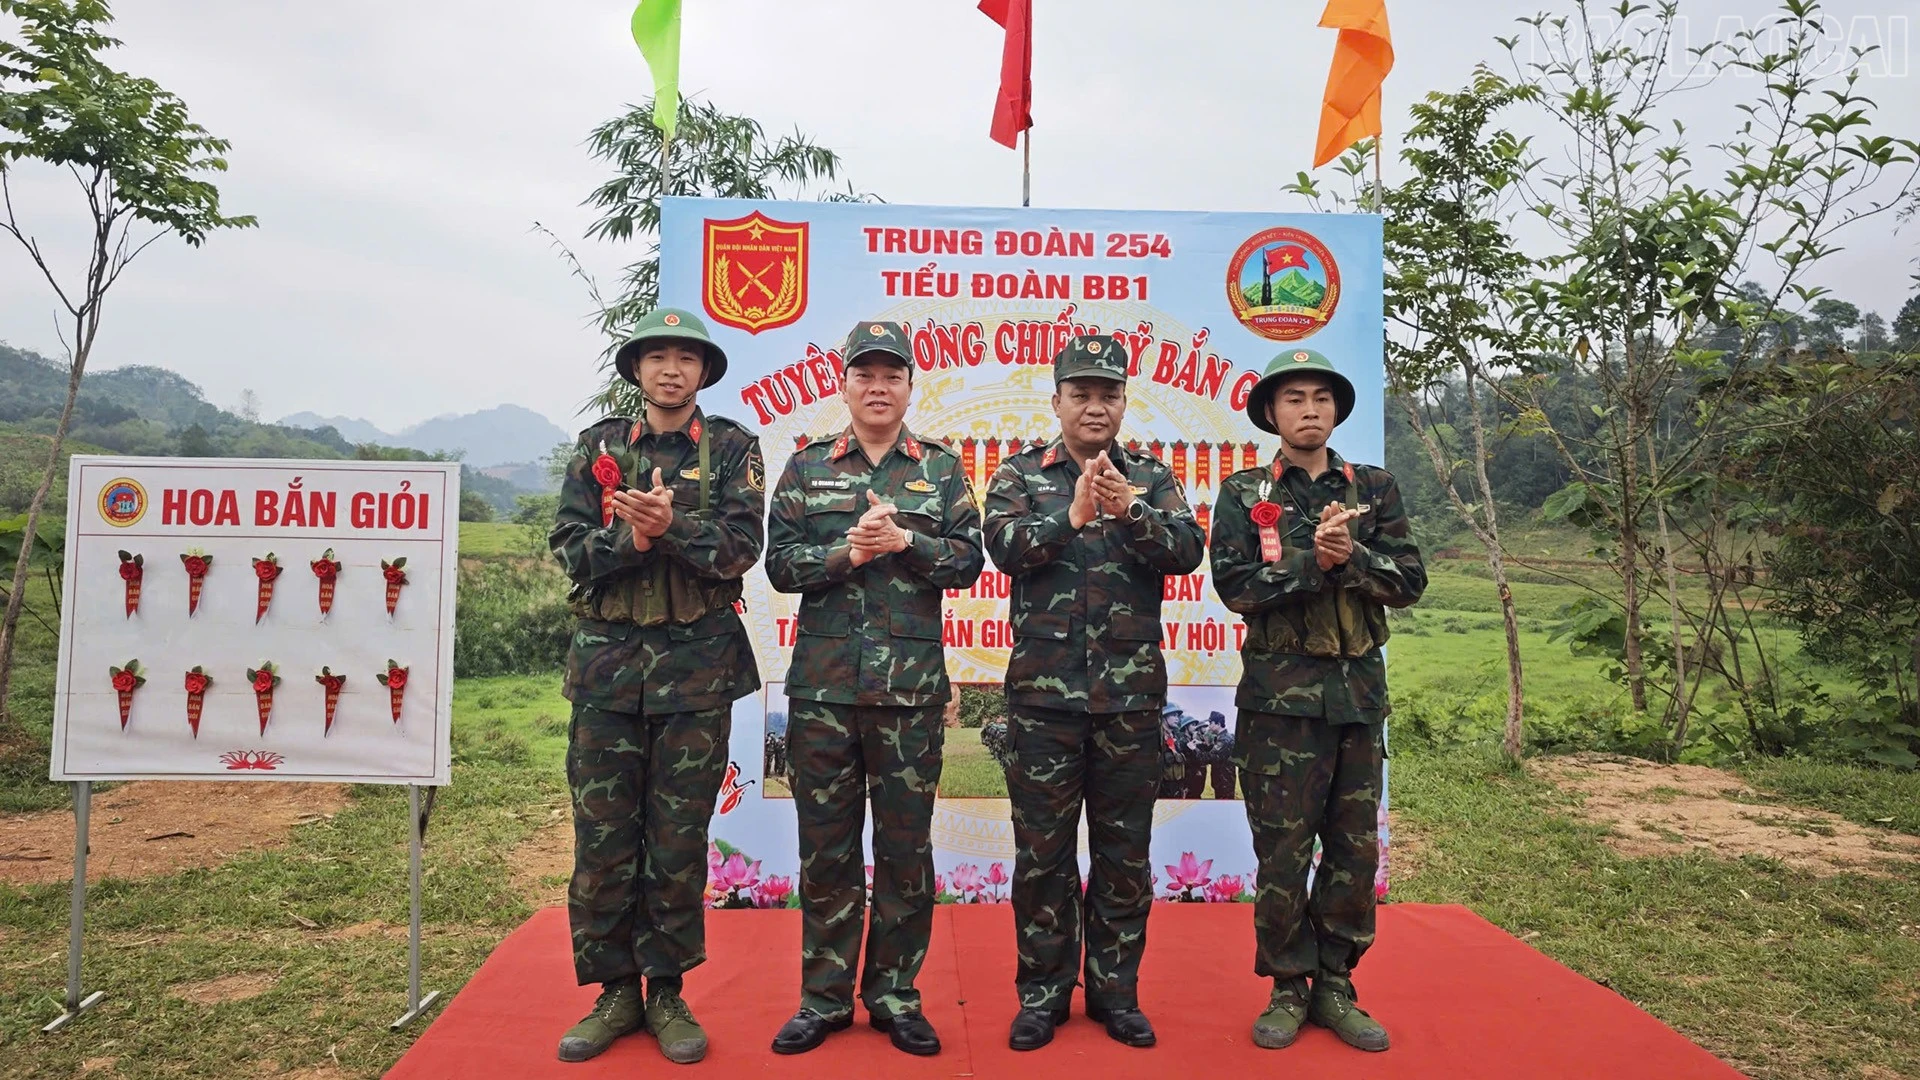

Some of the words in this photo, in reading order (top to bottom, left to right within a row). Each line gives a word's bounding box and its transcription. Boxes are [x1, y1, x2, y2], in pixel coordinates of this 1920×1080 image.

[863, 228, 984, 254] TRUNG
[995, 226, 1094, 257] ĐOÀN
[1106, 233, 1172, 258] 254
[881, 262, 959, 297] TIỂU
[970, 269, 1070, 300] ĐOÀN
[1083, 275, 1147, 301] BB1
[1255, 316, 1278, 324] TRUNG
[907, 319, 985, 371] ƠNG
[1152, 328, 1233, 402] BẮN
[162, 489, 241, 526] HOA
[254, 476, 337, 528] BẮN
[350, 480, 430, 529] GIỎI
[942, 609, 974, 648] ẮN
[1187, 617, 1225, 657] HỘI
